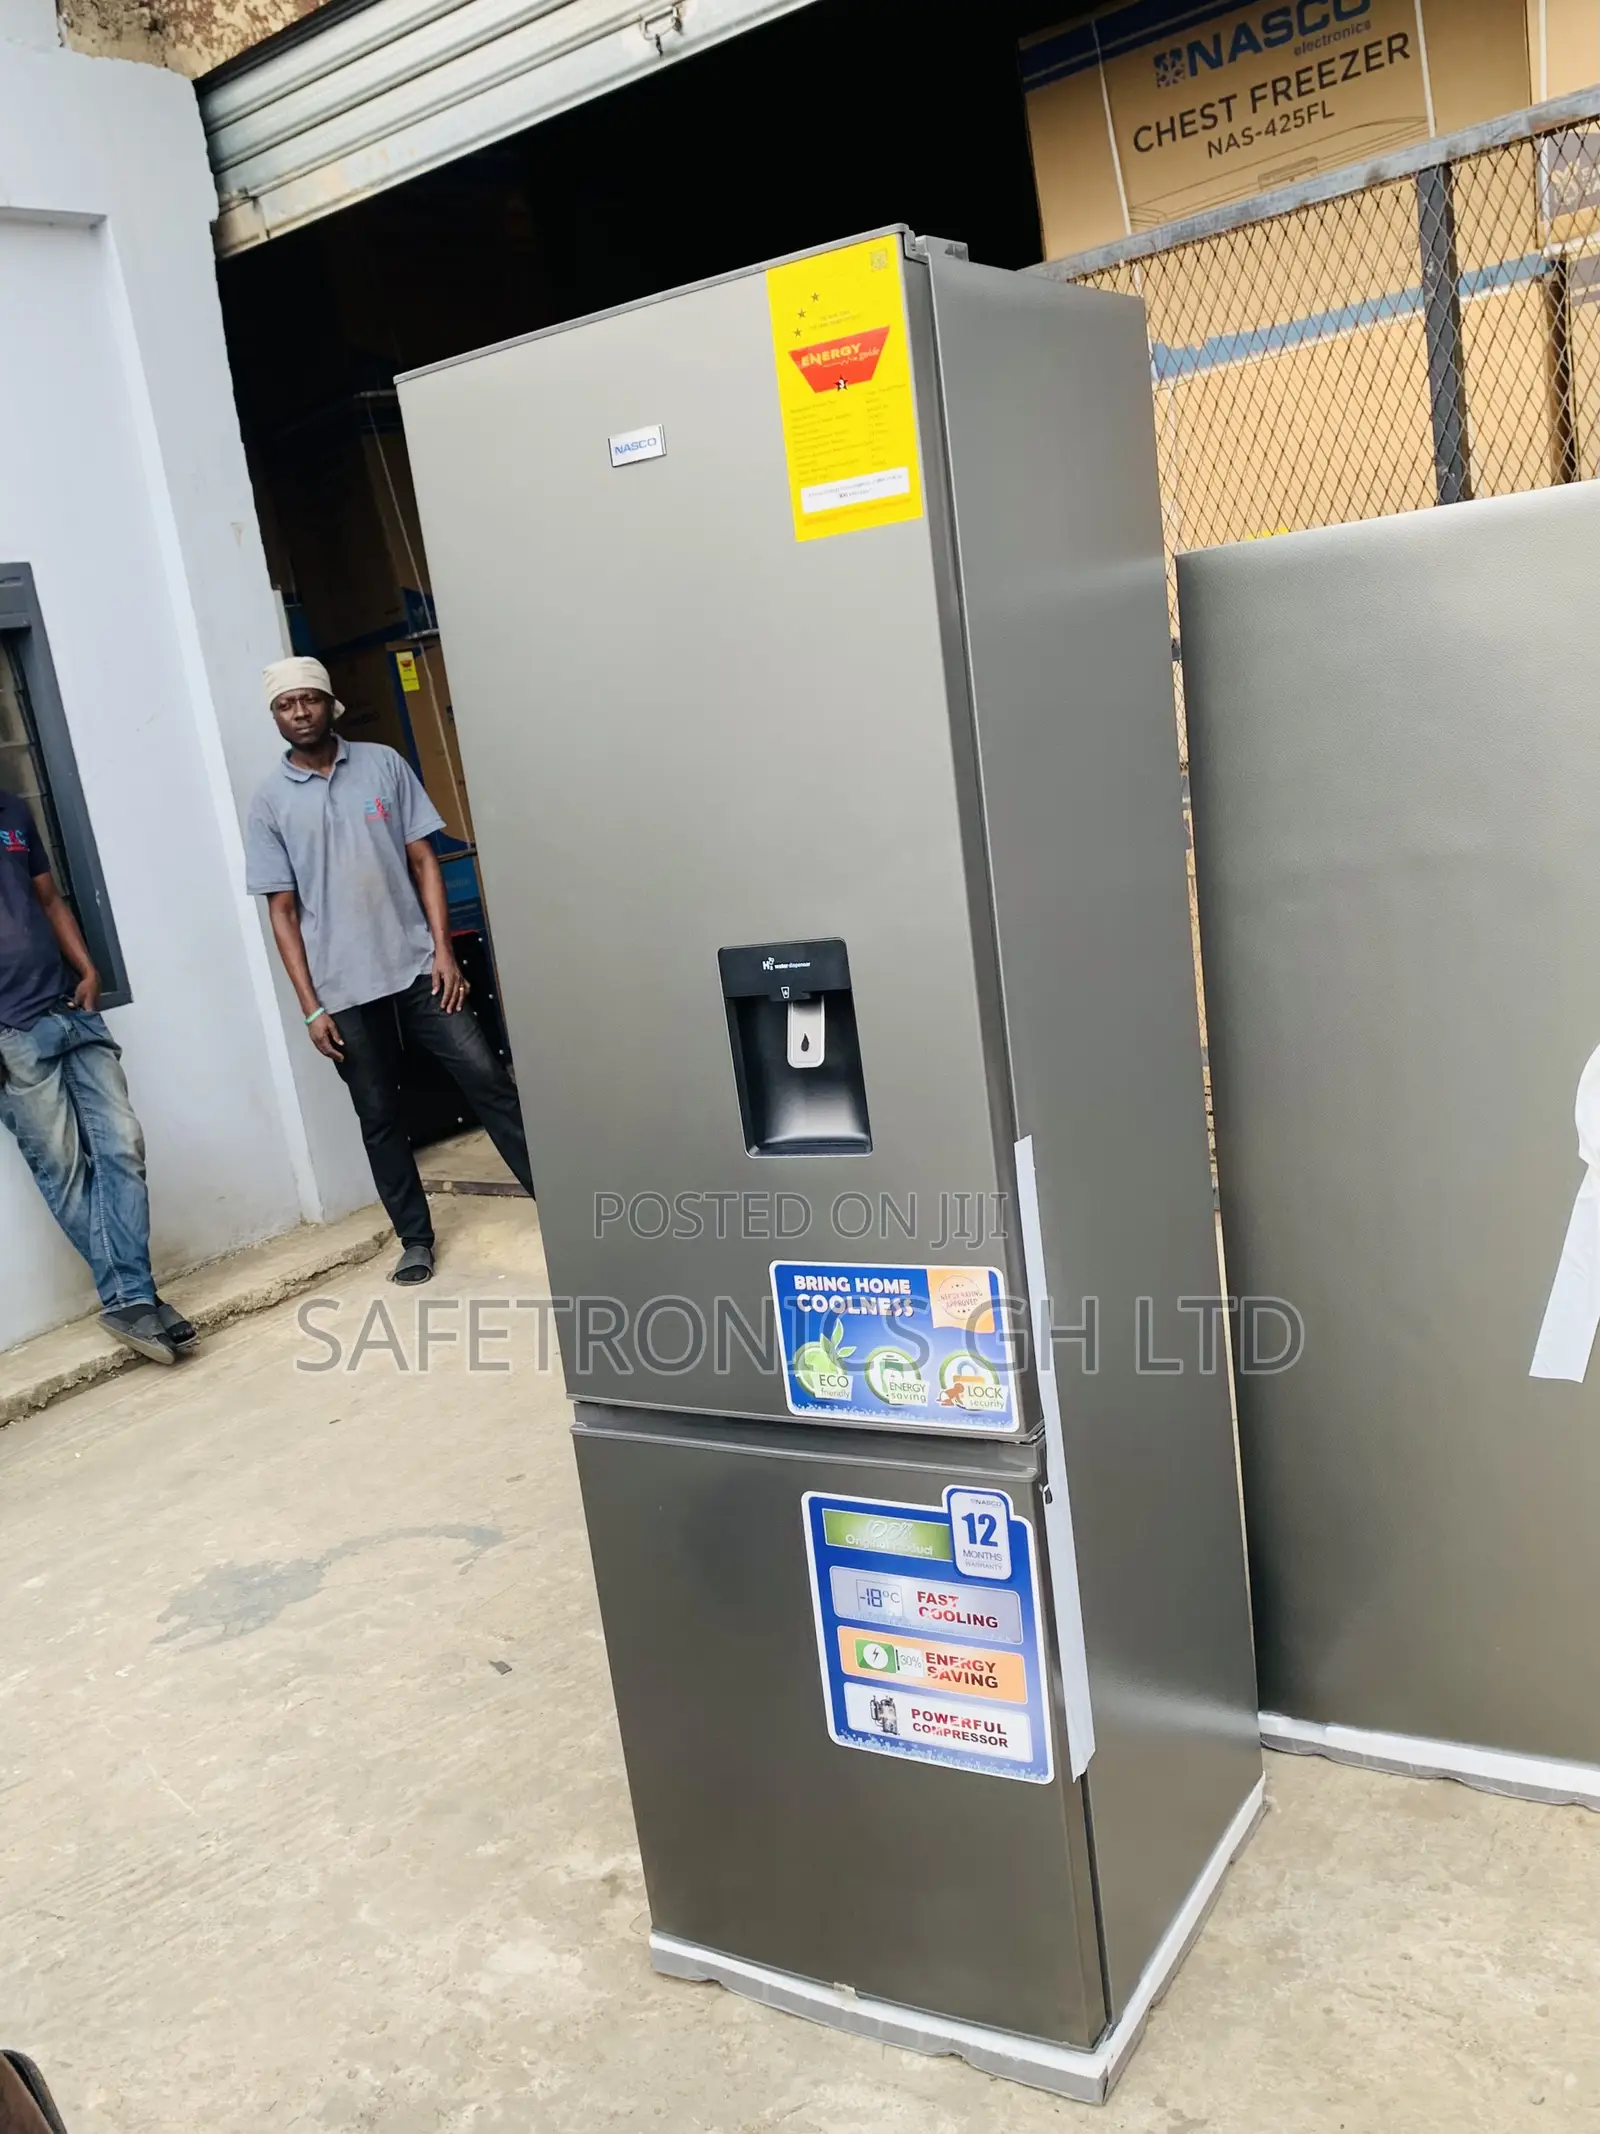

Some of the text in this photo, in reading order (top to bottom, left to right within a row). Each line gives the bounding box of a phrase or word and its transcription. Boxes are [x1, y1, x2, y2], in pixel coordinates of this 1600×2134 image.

[1293, 20, 1371, 57] electronics
[1133, 31, 1410, 153] CHEST FREEZER
[1207, 100, 1335, 158] NAS-425FL
[801, 342, 862, 367] ENERGY
[614, 437, 657, 455] NASCO
[793, 1275, 911, 1294] BRING HOME
[797, 1293, 914, 1317] COOLNESS
[819, 1374, 849, 1388] ECO
[889, 1382, 926, 1393] ENERGY
[820, 1387, 850, 1399] friendly
[891, 1392, 927, 1404] saving
[967, 1385, 1003, 1399] LOCK
[970, 1398, 1006, 1410] security
[961, 1512, 998, 1547] 12
[963, 1549, 1003, 1562] MONTHS
[964, 1560, 1003, 1571] WARRANTY
[917, 1591, 959, 1607] FAST
[918, 1606, 998, 1628] COOLING
[900, 1654, 922, 1668] 30%
[925, 1652, 996, 1673] ENERGY
[927, 1666, 998, 1688] SAVING
[911, 1708, 1007, 1735] POWERFUL
[912, 1722, 1009, 1748] COMPRESSOR
